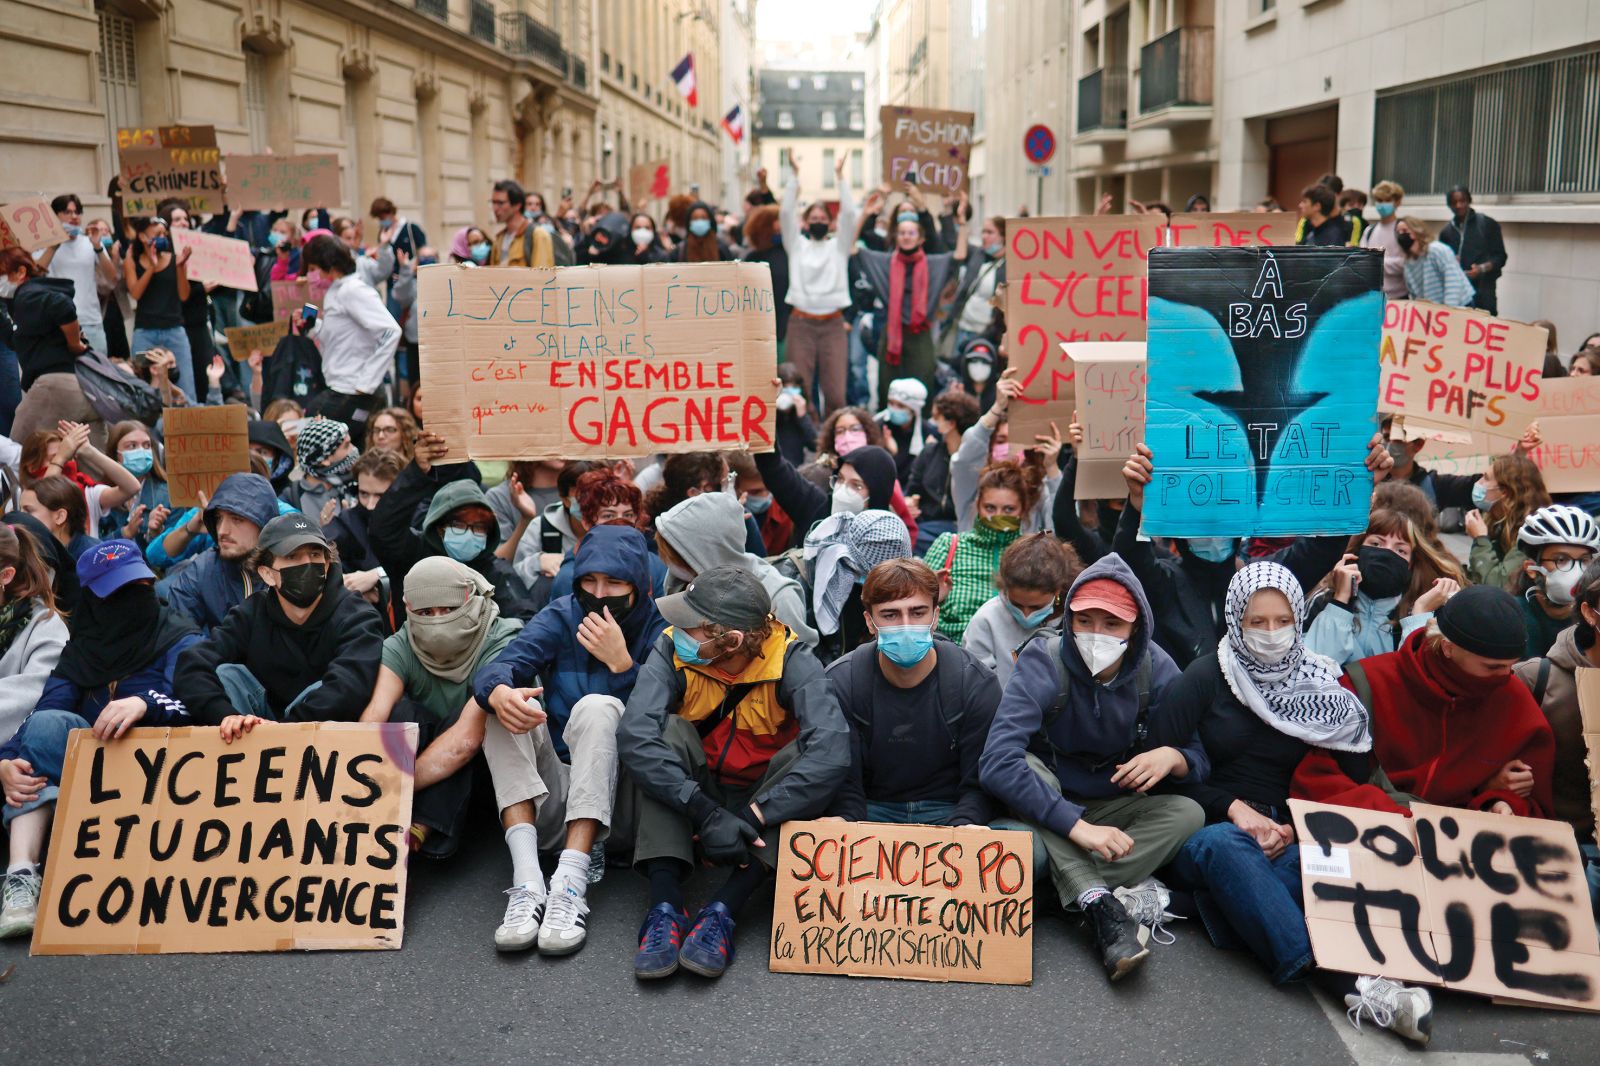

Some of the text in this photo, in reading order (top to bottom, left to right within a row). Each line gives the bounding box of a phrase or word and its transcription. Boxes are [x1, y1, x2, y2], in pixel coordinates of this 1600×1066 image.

[895, 118, 974, 146] FASHION
[892, 156, 962, 192] FACHO
[1012, 227, 1074, 260] ON
[1083, 224, 1197, 260] VEUT
[1252, 250, 1283, 299] À
[447, 276, 640, 327] LYCÉENS
[1228, 302, 1308, 339] BAS
[504, 333, 655, 360] et SALARIES
[1383, 303, 1510, 352] OINS DE
[472, 359, 734, 392] c'est ENSEMBLE
[1383, 373, 1507, 427] E PAFS
[1464, 352, 1543, 401] PLUS
[472, 400, 519, 435] qu'on
[568, 395, 772, 447] GAGNER
[1161, 469, 1355, 506] POLICIER
[90, 744, 383, 808] LYCEENS
[74, 814, 404, 870] ETUDIANTS
[976, 840, 1025, 895] PO
[58, 873, 400, 930] CONVERGENCE
[794, 885, 1033, 938] EN LUTTE CONTRE
[774, 922, 796, 960] la
[1311, 881, 1593, 1001] TUE
